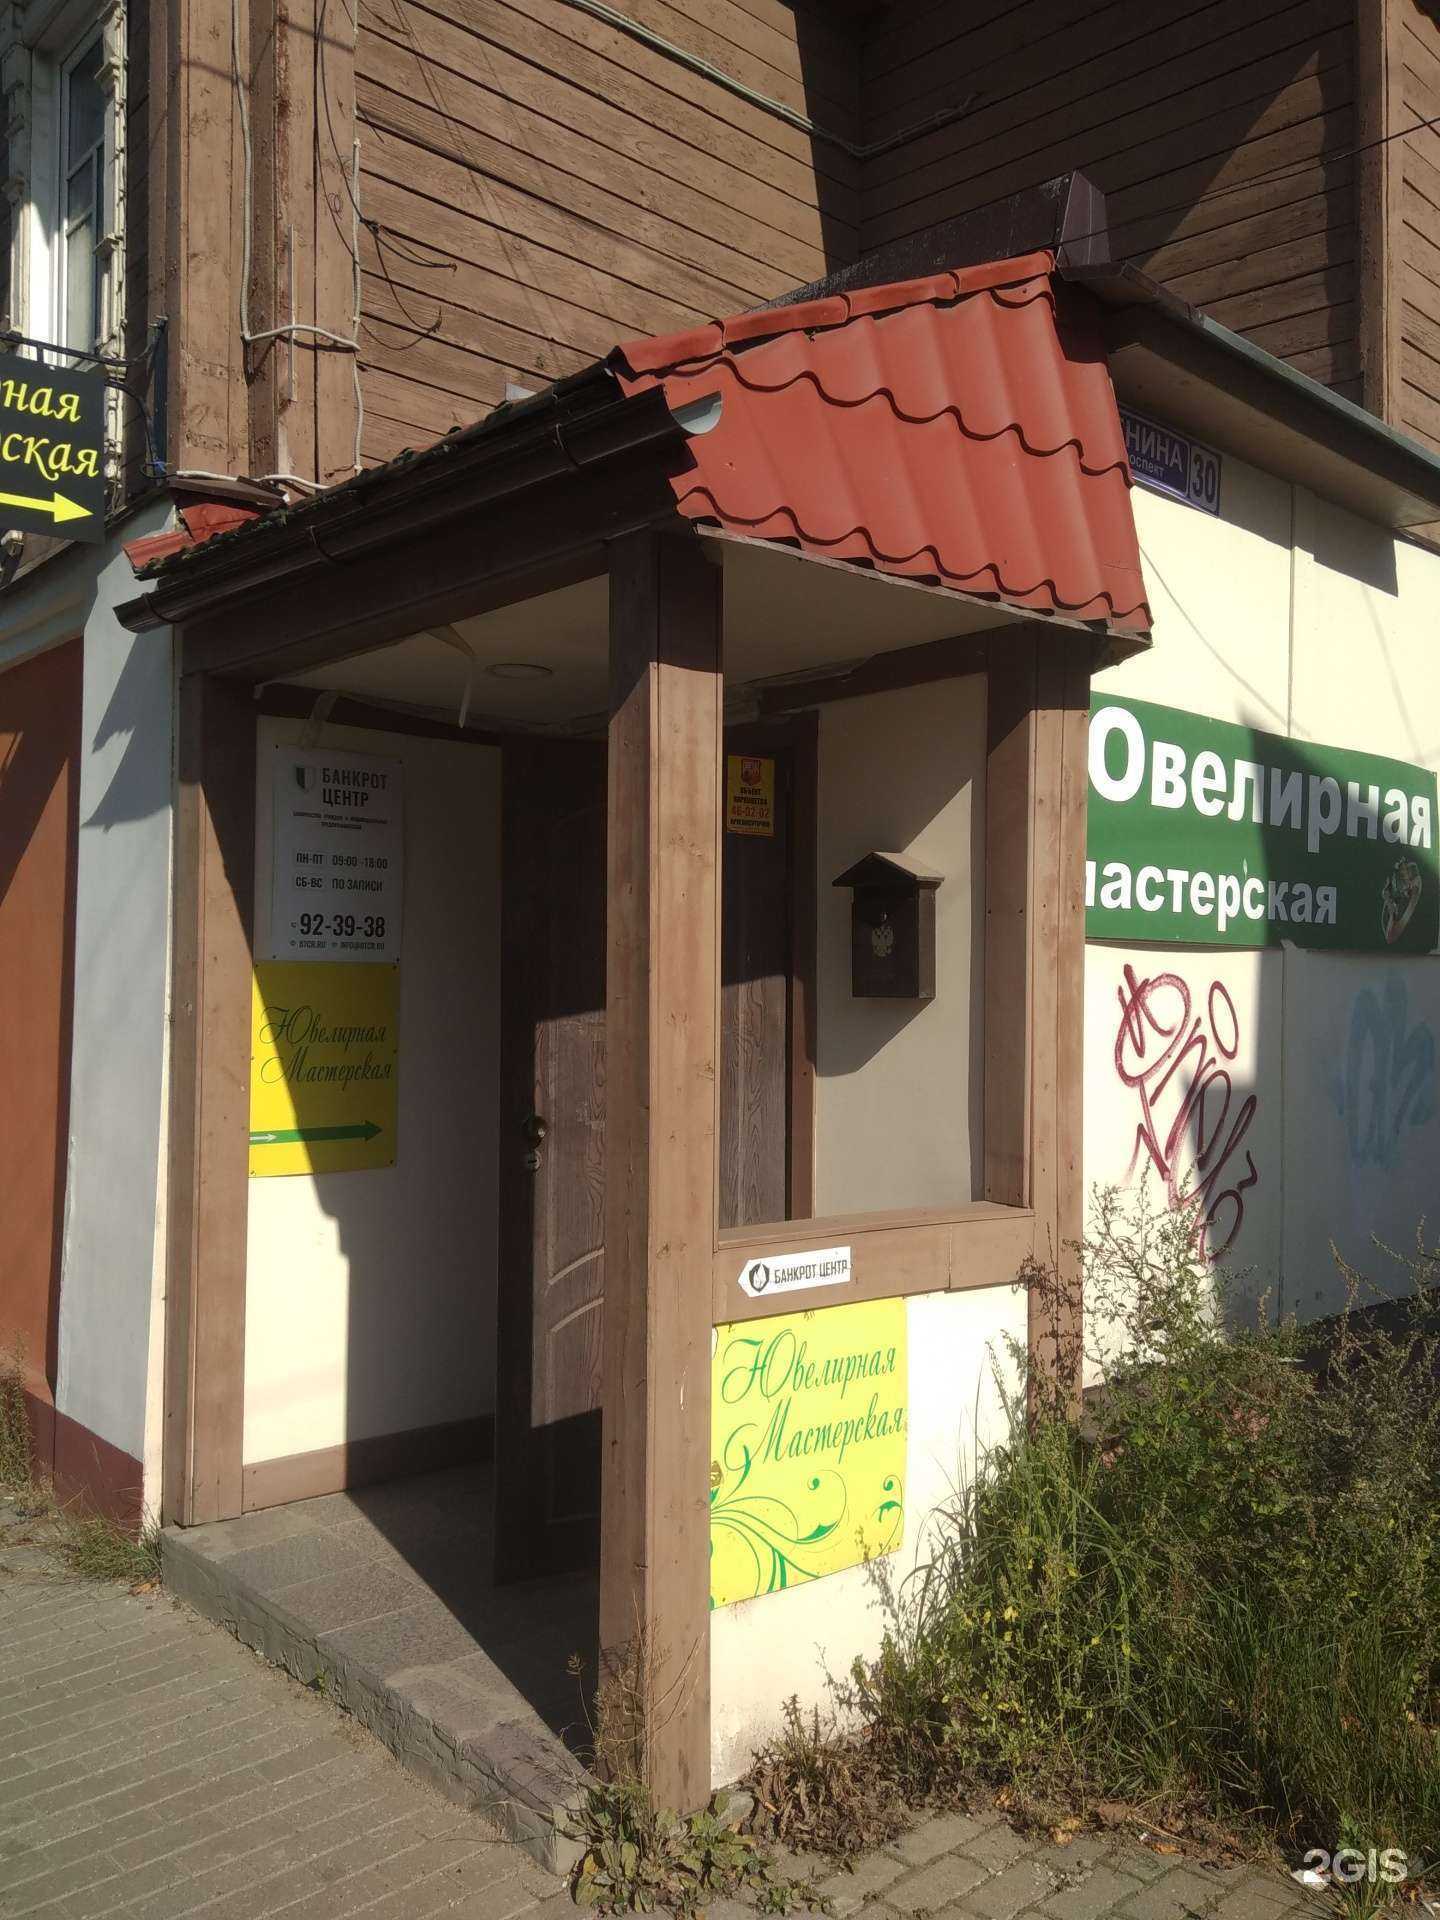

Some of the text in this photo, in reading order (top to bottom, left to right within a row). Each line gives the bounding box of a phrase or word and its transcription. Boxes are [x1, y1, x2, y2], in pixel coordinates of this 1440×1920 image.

[0, 379, 81, 424] ная
[0, 433, 99, 481] ская
[1121, 417, 1215, 503] НИНА 30
[322, 768, 388, 789] БАНКРОТ
[322, 788, 369, 807] ЦЕНТР
[296, 853, 324, 865] ПН-ПТ
[332, 879, 345, 889] ПО
[347, 880, 383, 892] ЗАПИСИ
[300, 913, 386, 937] 92-39-38
[260, 1006, 387, 1050] Ювелирная
[261, 1047, 392, 1091] Мастерская
[774, 1260, 848, 1284] БАНКРОТ ЦЕНТР
[722, 1329, 896, 1404] Ювелирная
[724, 1392, 904, 1471] Мастерская
